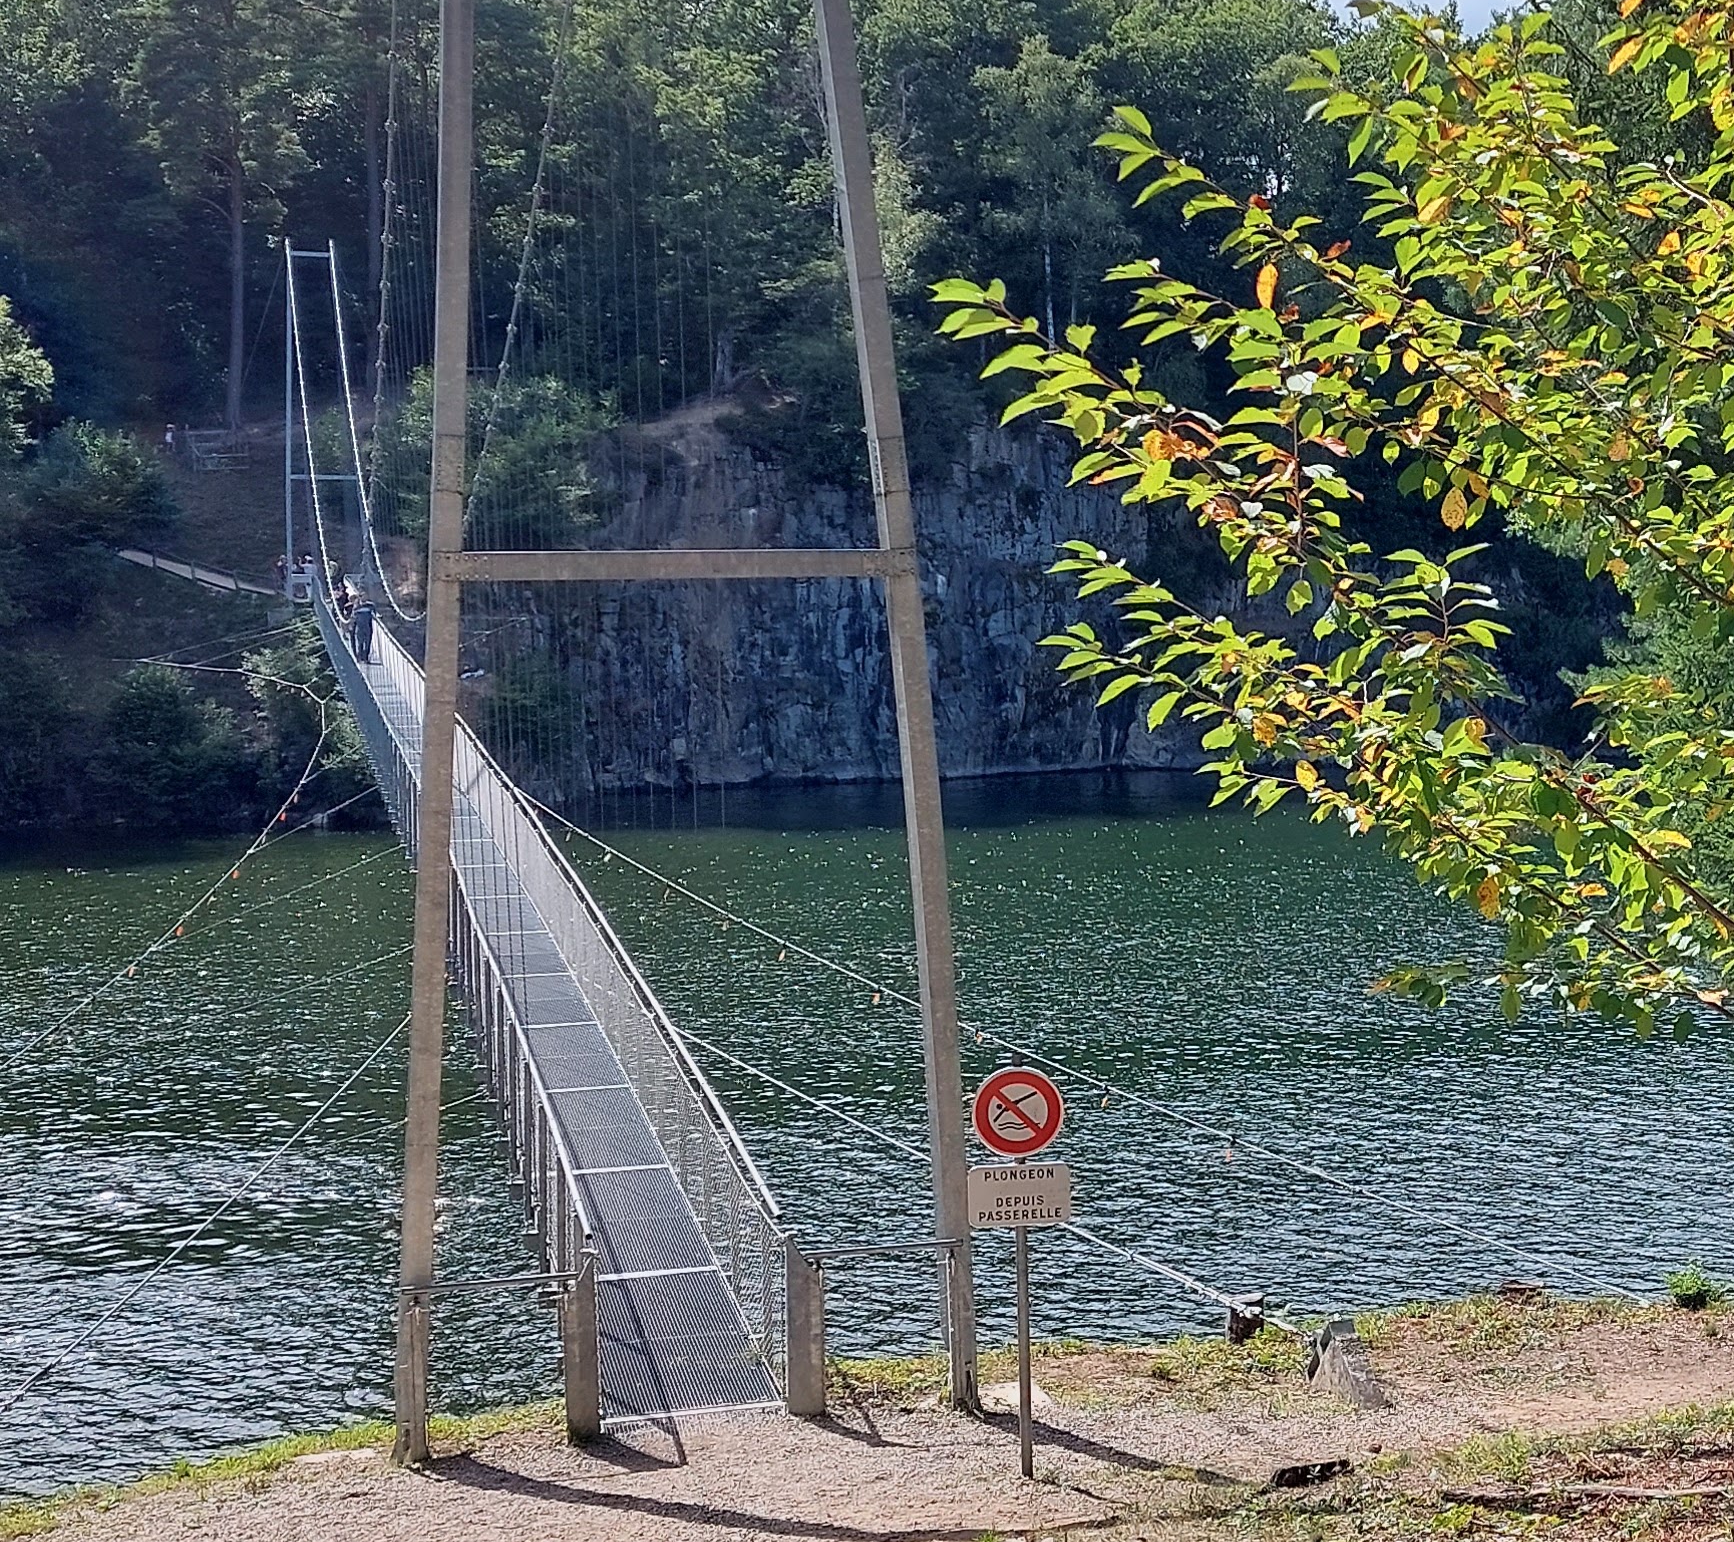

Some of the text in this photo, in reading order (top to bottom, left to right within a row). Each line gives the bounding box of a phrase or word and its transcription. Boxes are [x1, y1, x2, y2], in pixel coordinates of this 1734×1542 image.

[984, 1168, 1054, 1182] PLONGEON
[996, 1195, 1044, 1207] DEPUIS
[979, 1207, 1062, 1221] PASSERELLE
